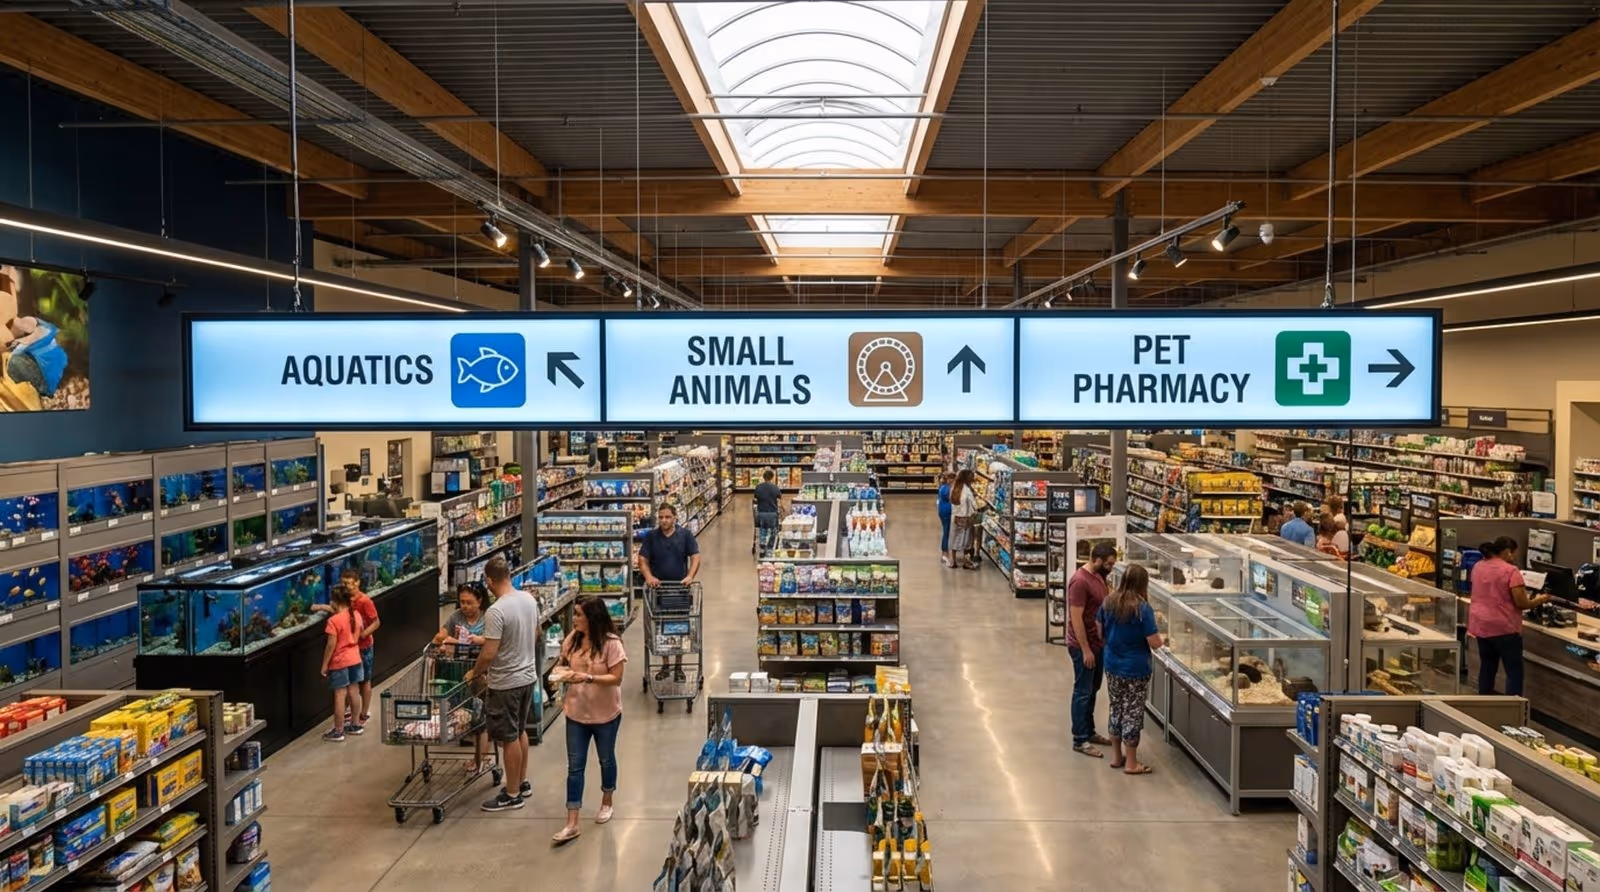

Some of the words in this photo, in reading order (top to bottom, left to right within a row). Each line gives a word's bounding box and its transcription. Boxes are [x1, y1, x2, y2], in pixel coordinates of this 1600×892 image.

[687, 335, 794, 366] SMALL
[1133, 334, 1191, 365] PET
[281, 354, 434, 387] AQUATICS
[669, 374, 811, 405] ANIMALS
[1073, 373, 1251, 404] PHARMACY
